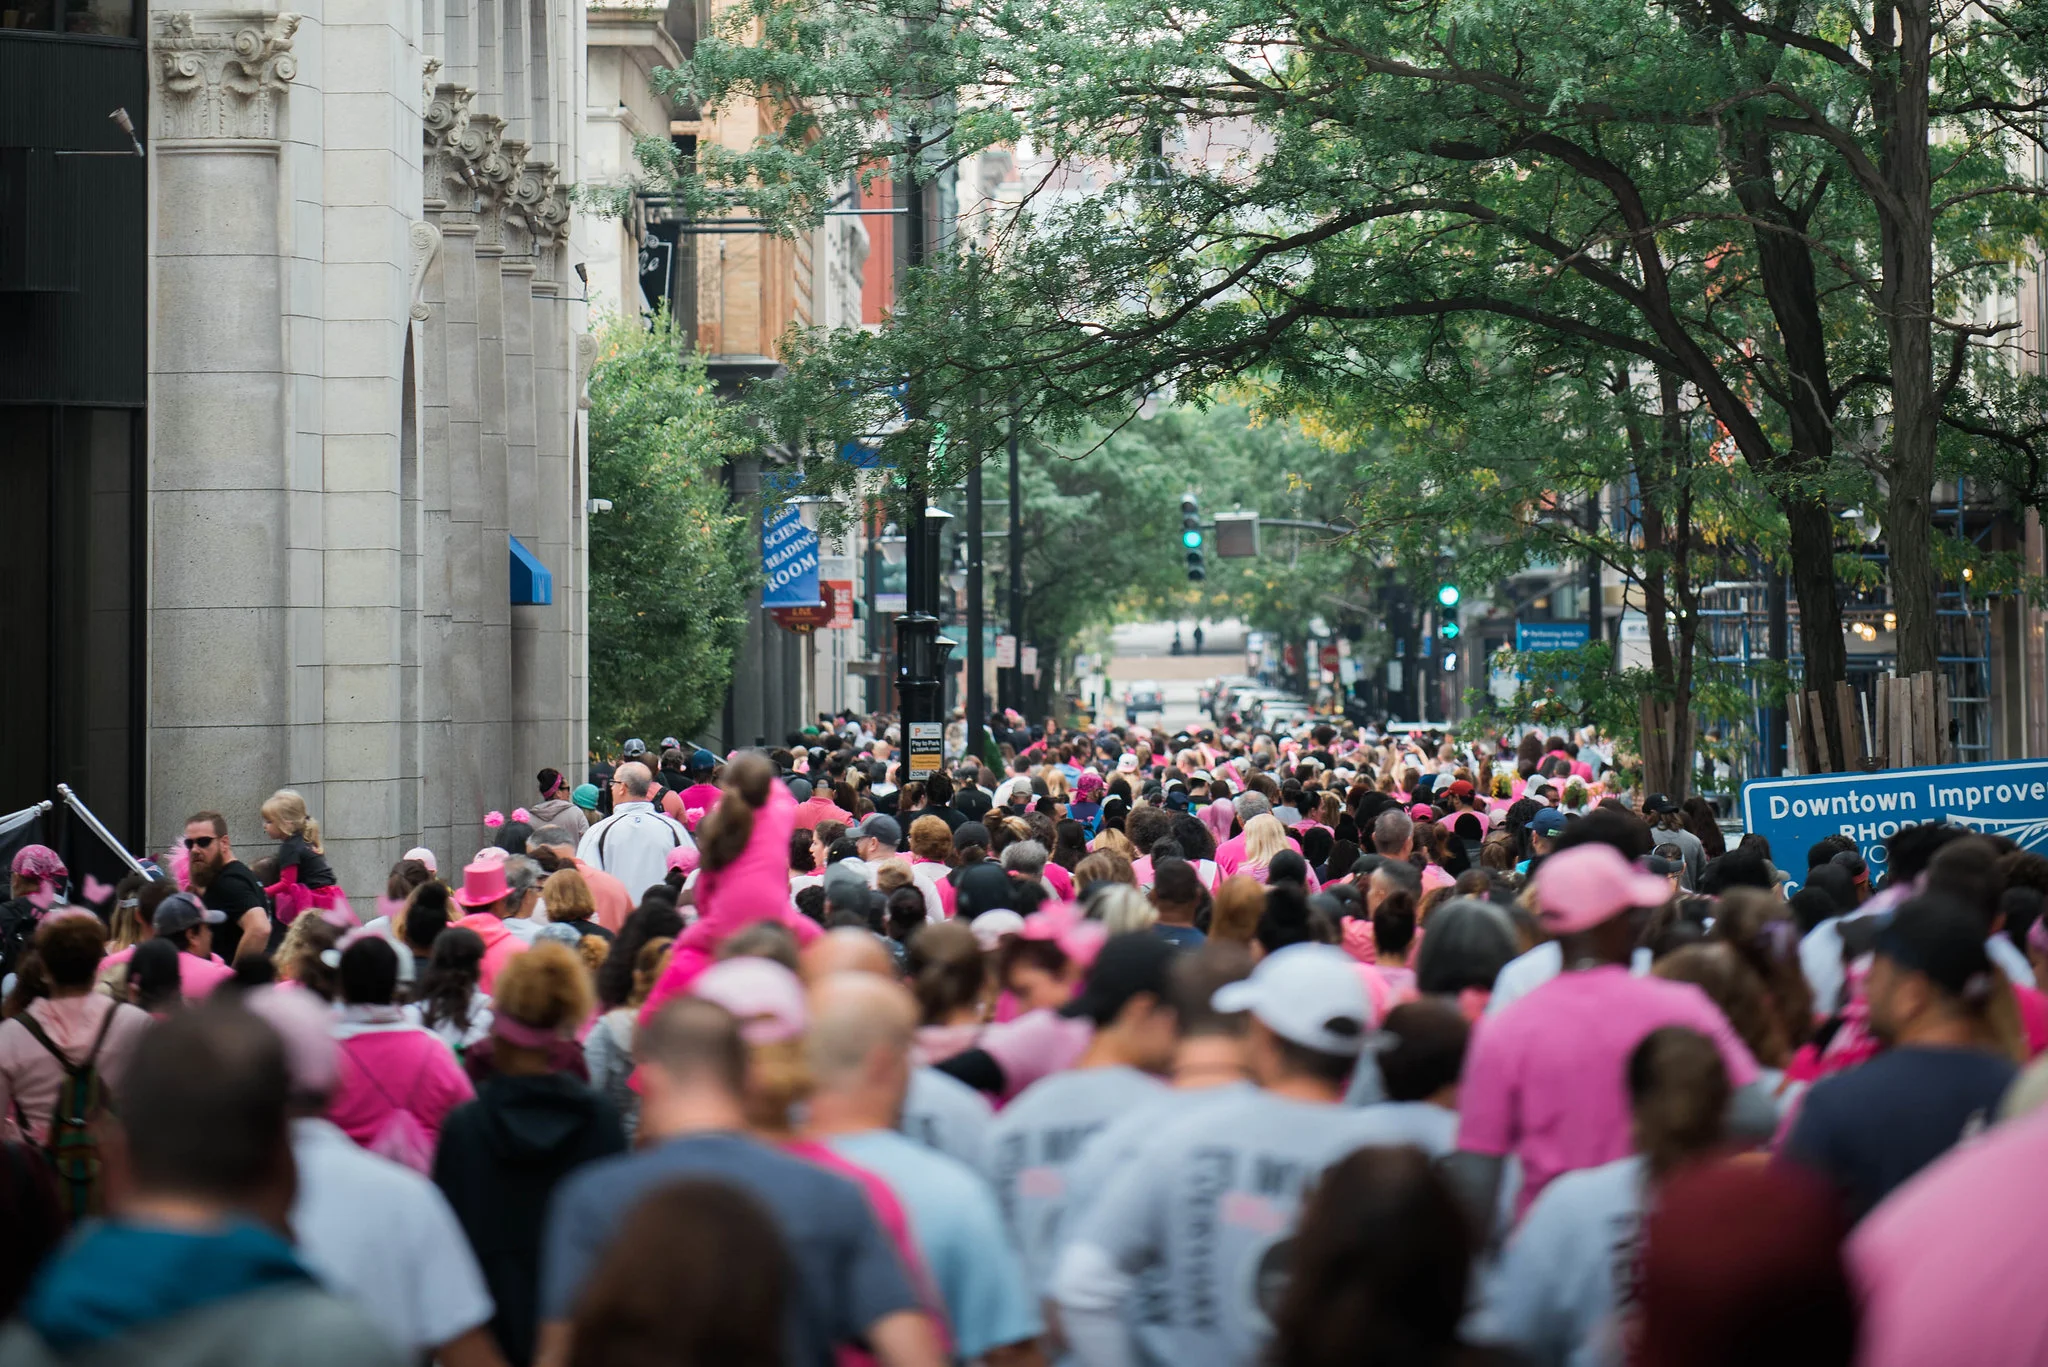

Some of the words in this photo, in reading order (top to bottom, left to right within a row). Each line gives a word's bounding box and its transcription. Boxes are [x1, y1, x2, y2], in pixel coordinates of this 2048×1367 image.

[764, 516, 803, 548] SCIEN
[765, 531, 817, 569] READING
[767, 552, 817, 592] ROOM
[1769, 790, 1916, 820] Downtown
[1928, 782, 2048, 811] Improve
[1839, 818, 1936, 842] RHO
